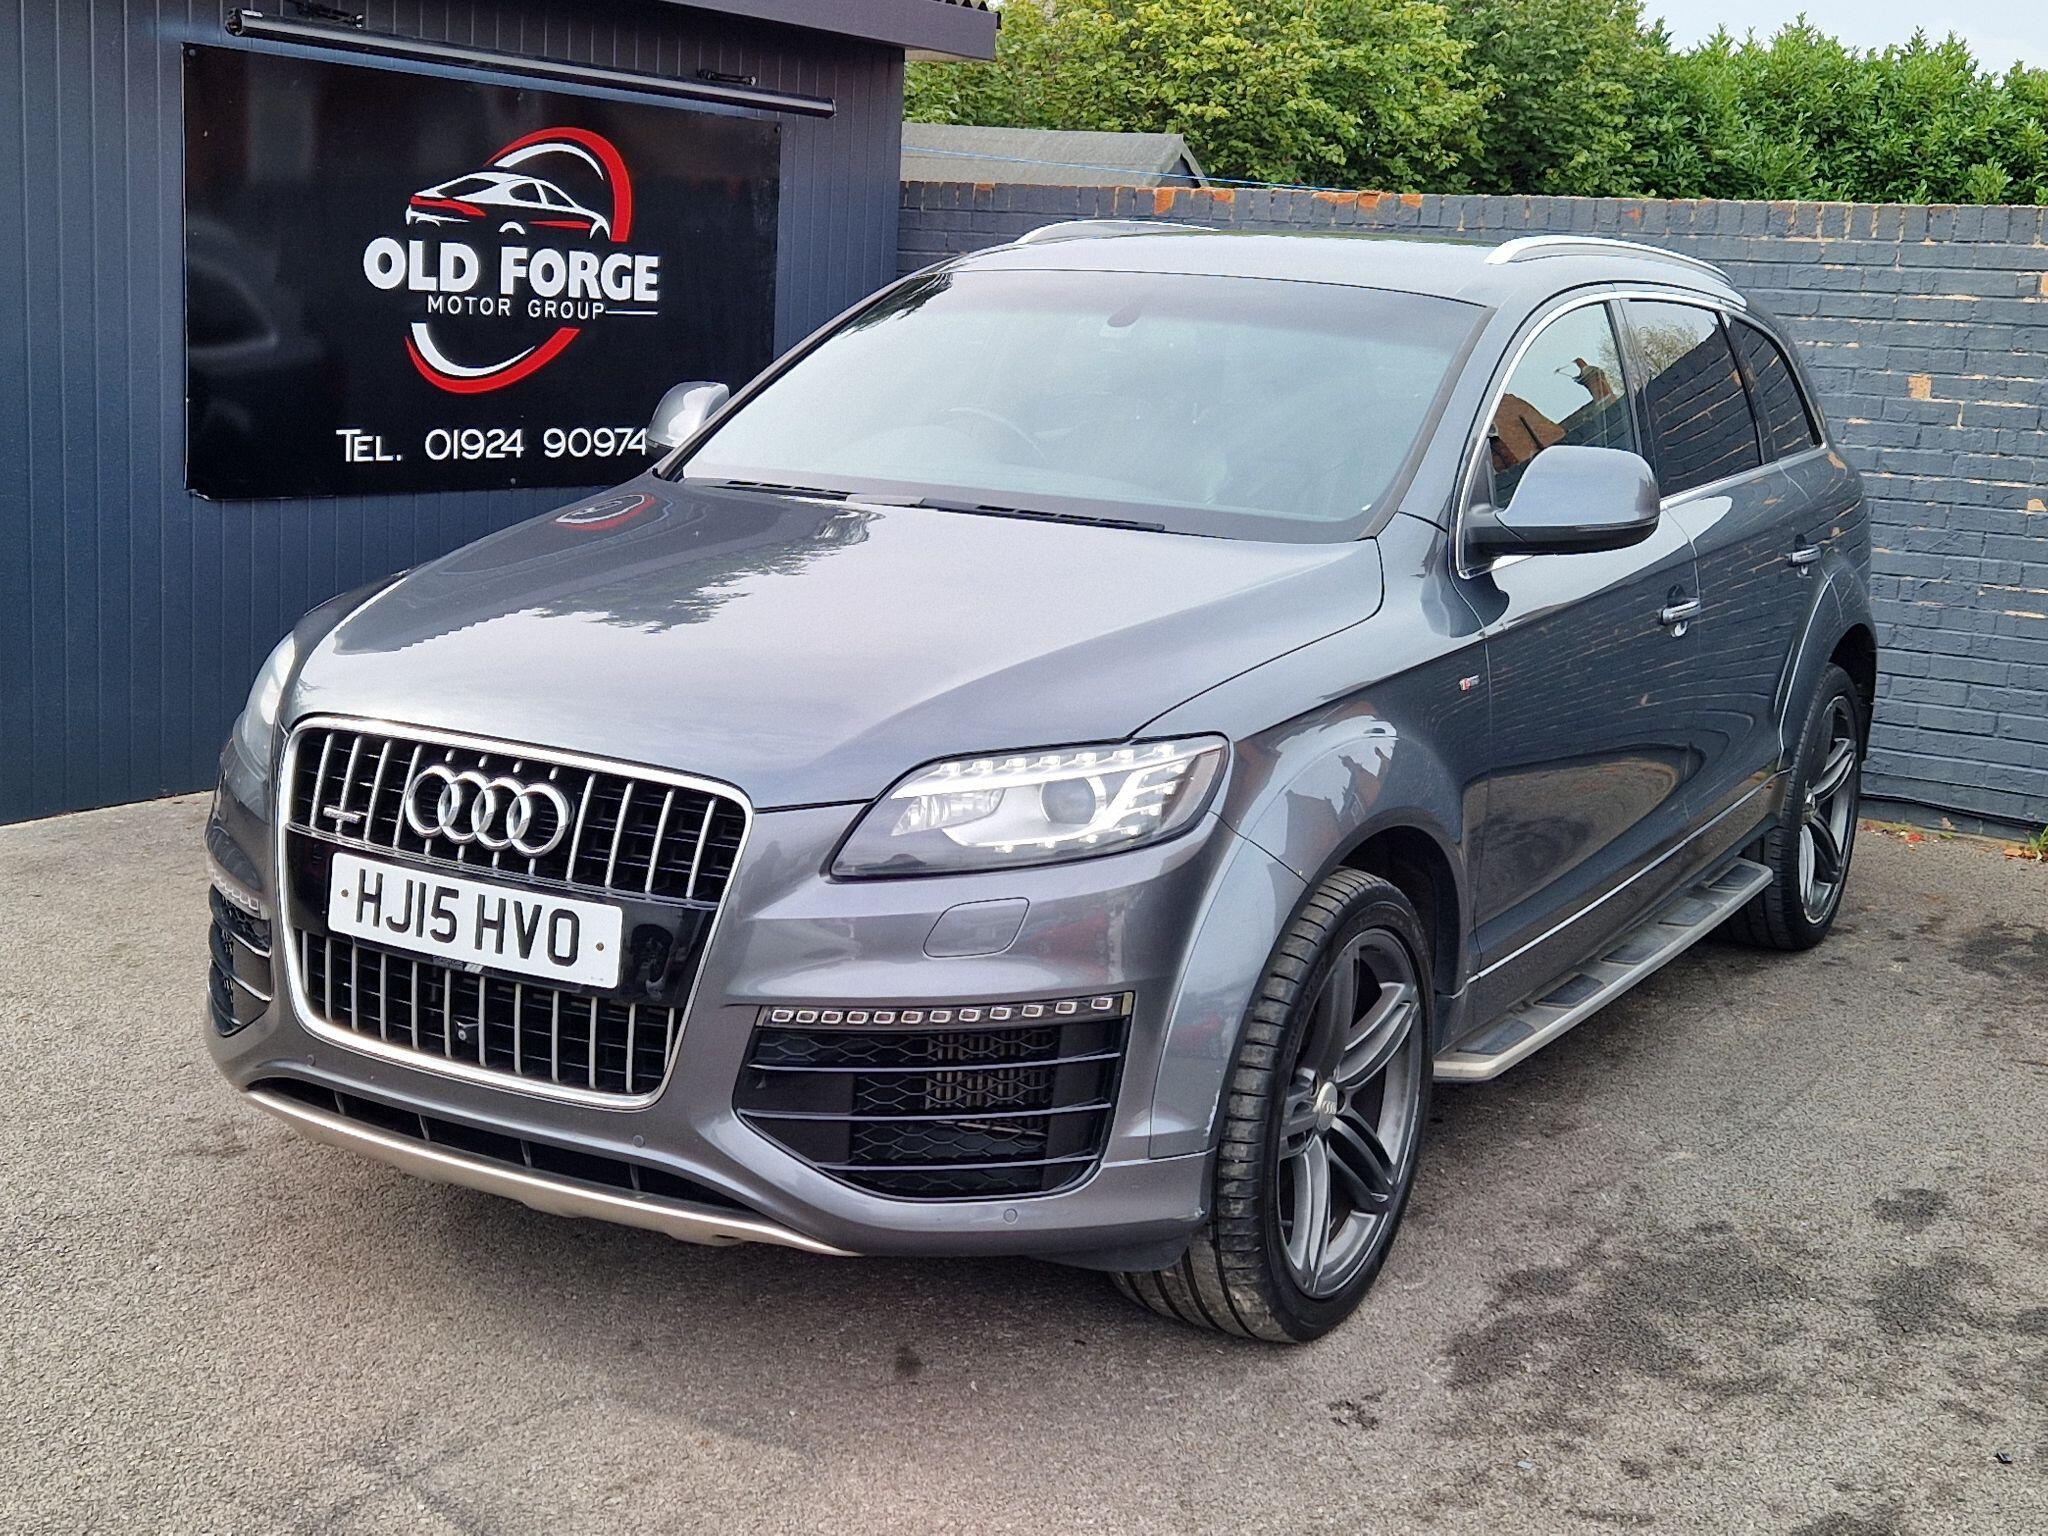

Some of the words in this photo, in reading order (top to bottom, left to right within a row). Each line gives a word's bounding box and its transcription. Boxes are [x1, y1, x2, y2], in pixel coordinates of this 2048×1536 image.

[363, 237, 479, 292] OLD
[500, 246, 659, 302] FORGE
[427, 294, 511, 317] MOTOR
[527, 299, 605, 320] GROUP
[424, 428, 524, 461] 01924
[355, 868, 460, 944] HJ15
[474, 893, 580, 967] HVO
